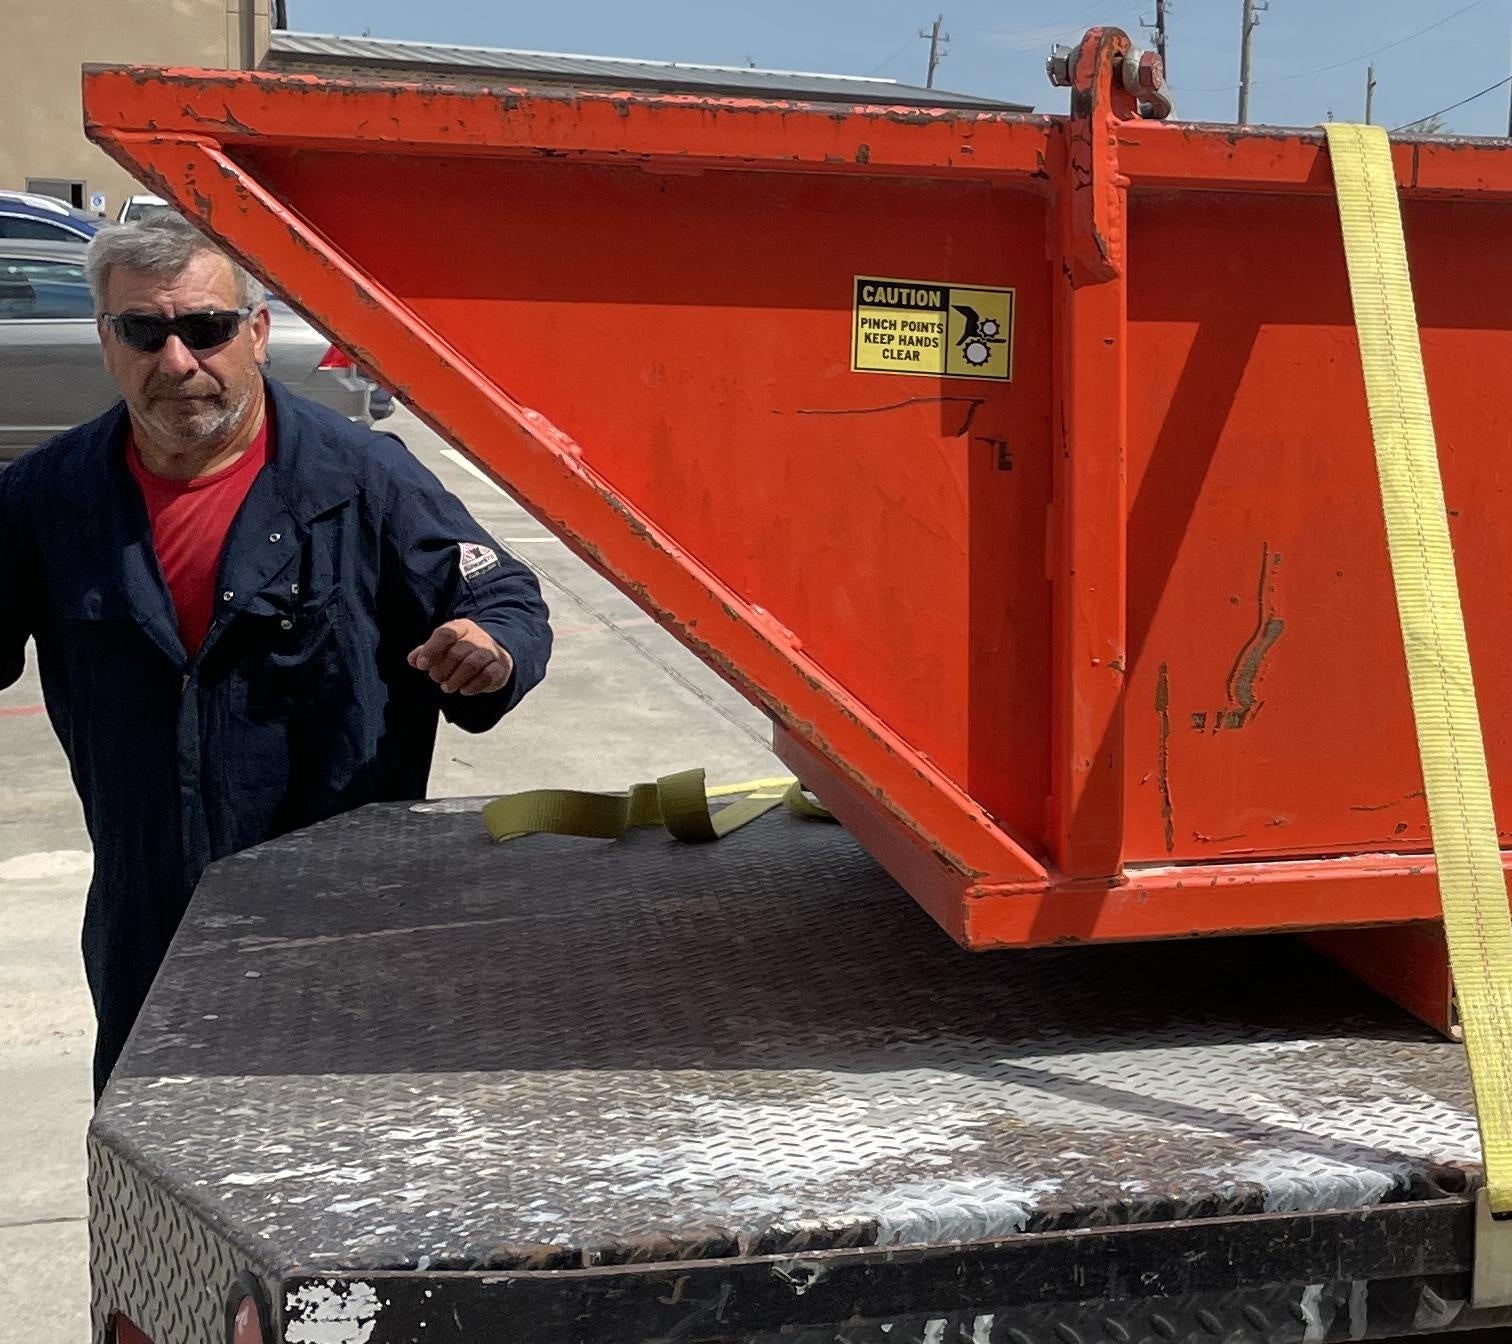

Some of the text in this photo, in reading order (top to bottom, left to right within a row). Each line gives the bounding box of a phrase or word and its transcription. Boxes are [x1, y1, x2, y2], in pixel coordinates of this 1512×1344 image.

[861, 285, 942, 308] CAUTION
[860, 317, 944, 334] PINCH POINTS
[863, 332, 940, 349] KEEP HANDS
[881, 348, 921, 362] CLEAR
